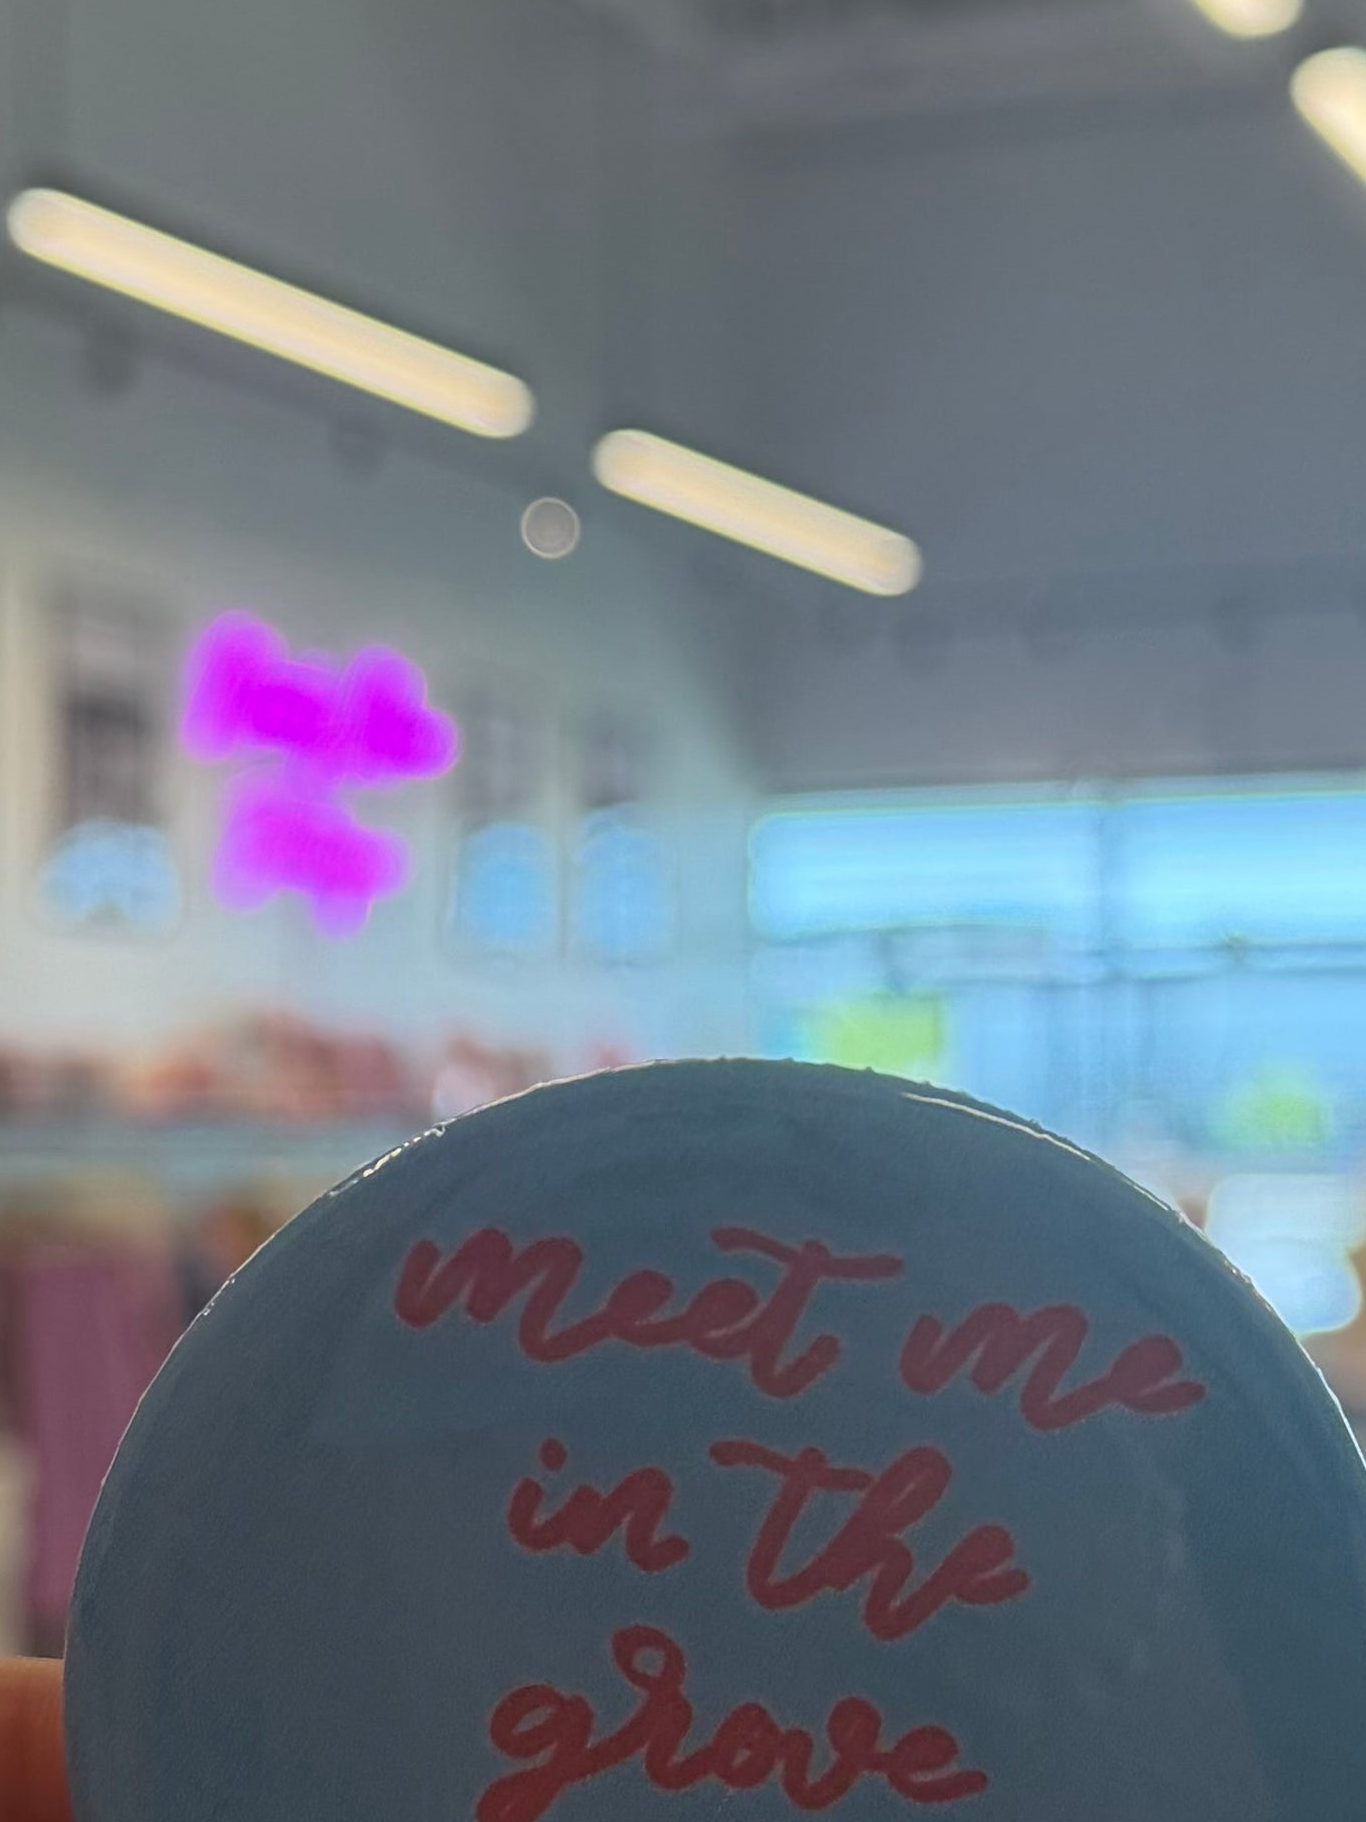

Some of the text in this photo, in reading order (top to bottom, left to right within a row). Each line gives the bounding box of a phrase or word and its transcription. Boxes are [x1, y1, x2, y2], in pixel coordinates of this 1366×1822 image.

[393, 1227, 1206, 1432] meet me
[506, 1438, 1029, 1642] in the
